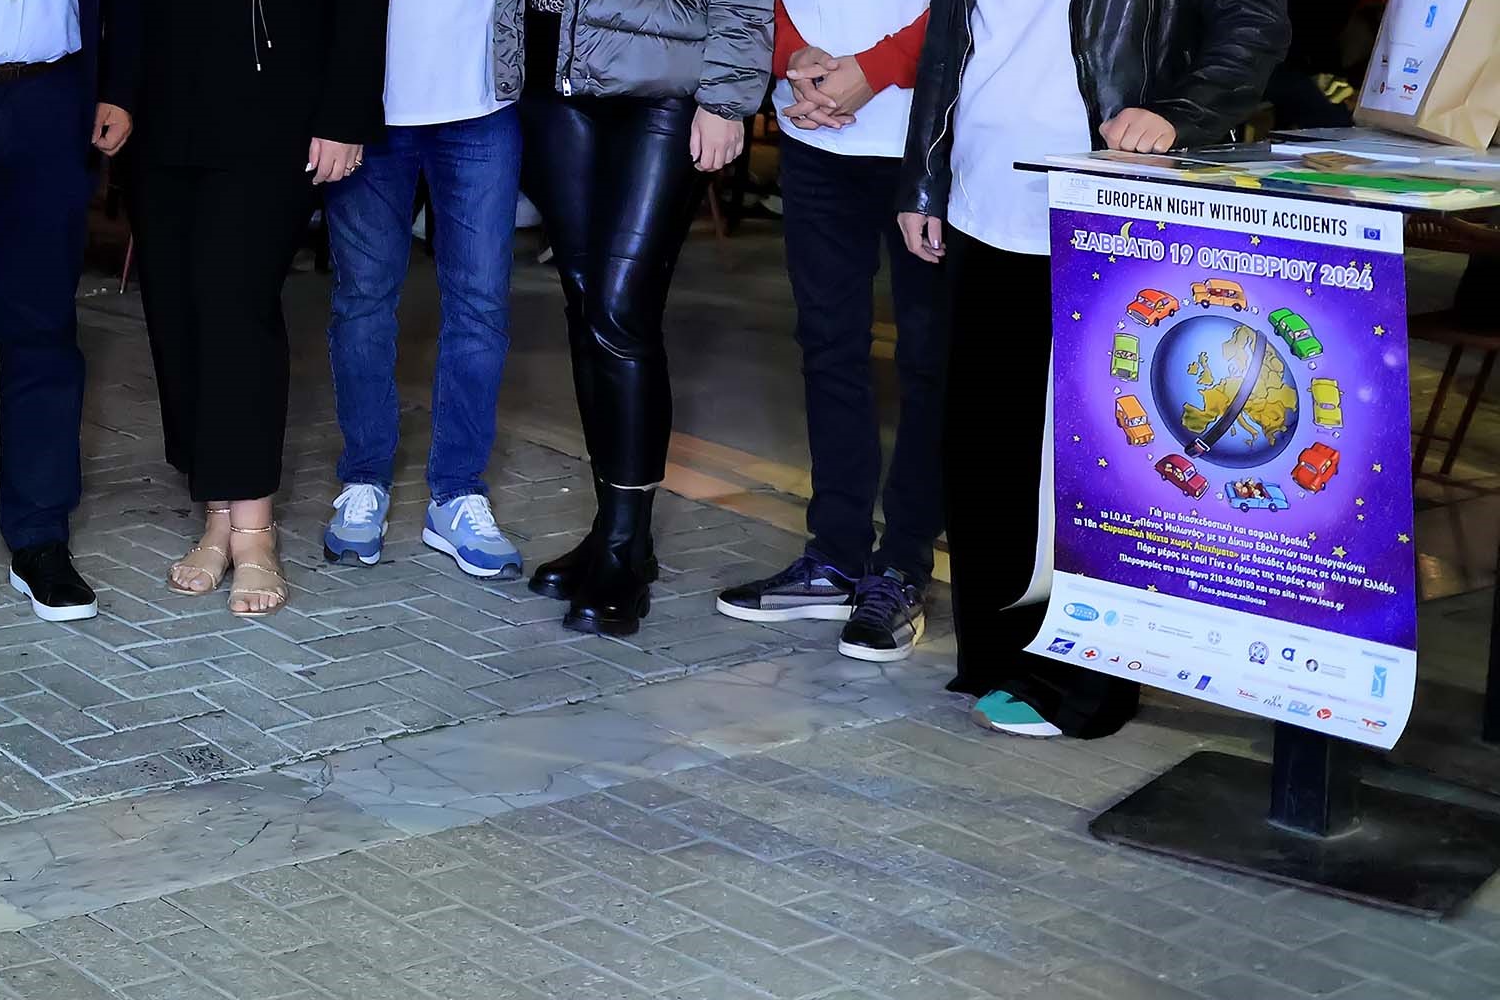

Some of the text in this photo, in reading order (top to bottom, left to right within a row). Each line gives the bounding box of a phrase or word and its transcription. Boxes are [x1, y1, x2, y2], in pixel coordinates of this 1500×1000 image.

[1097, 189, 1348, 236] EUROPEAN NIGHT WITHOUT ACCIDENTS
[1074, 229, 1374, 292] ΣΑΒΒΑΤΟ 19 ΟΚΤΩΒΡΙΟΥ 2024
[1206, 533, 1217, 542] με
[1218, 535, 1227, 544] το
[1255, 541, 1298, 559] Εθελοντών
[1299, 552, 1314, 562] του
[1233, 525, 1247, 535] και
[1248, 528, 1279, 542] ασφαλή
[1240, 552, 1251, 562] με
[1252, 553, 1285, 571] δεκάδες
[1318, 570, 1330, 579] σε
[1348, 576, 1362, 587] την
